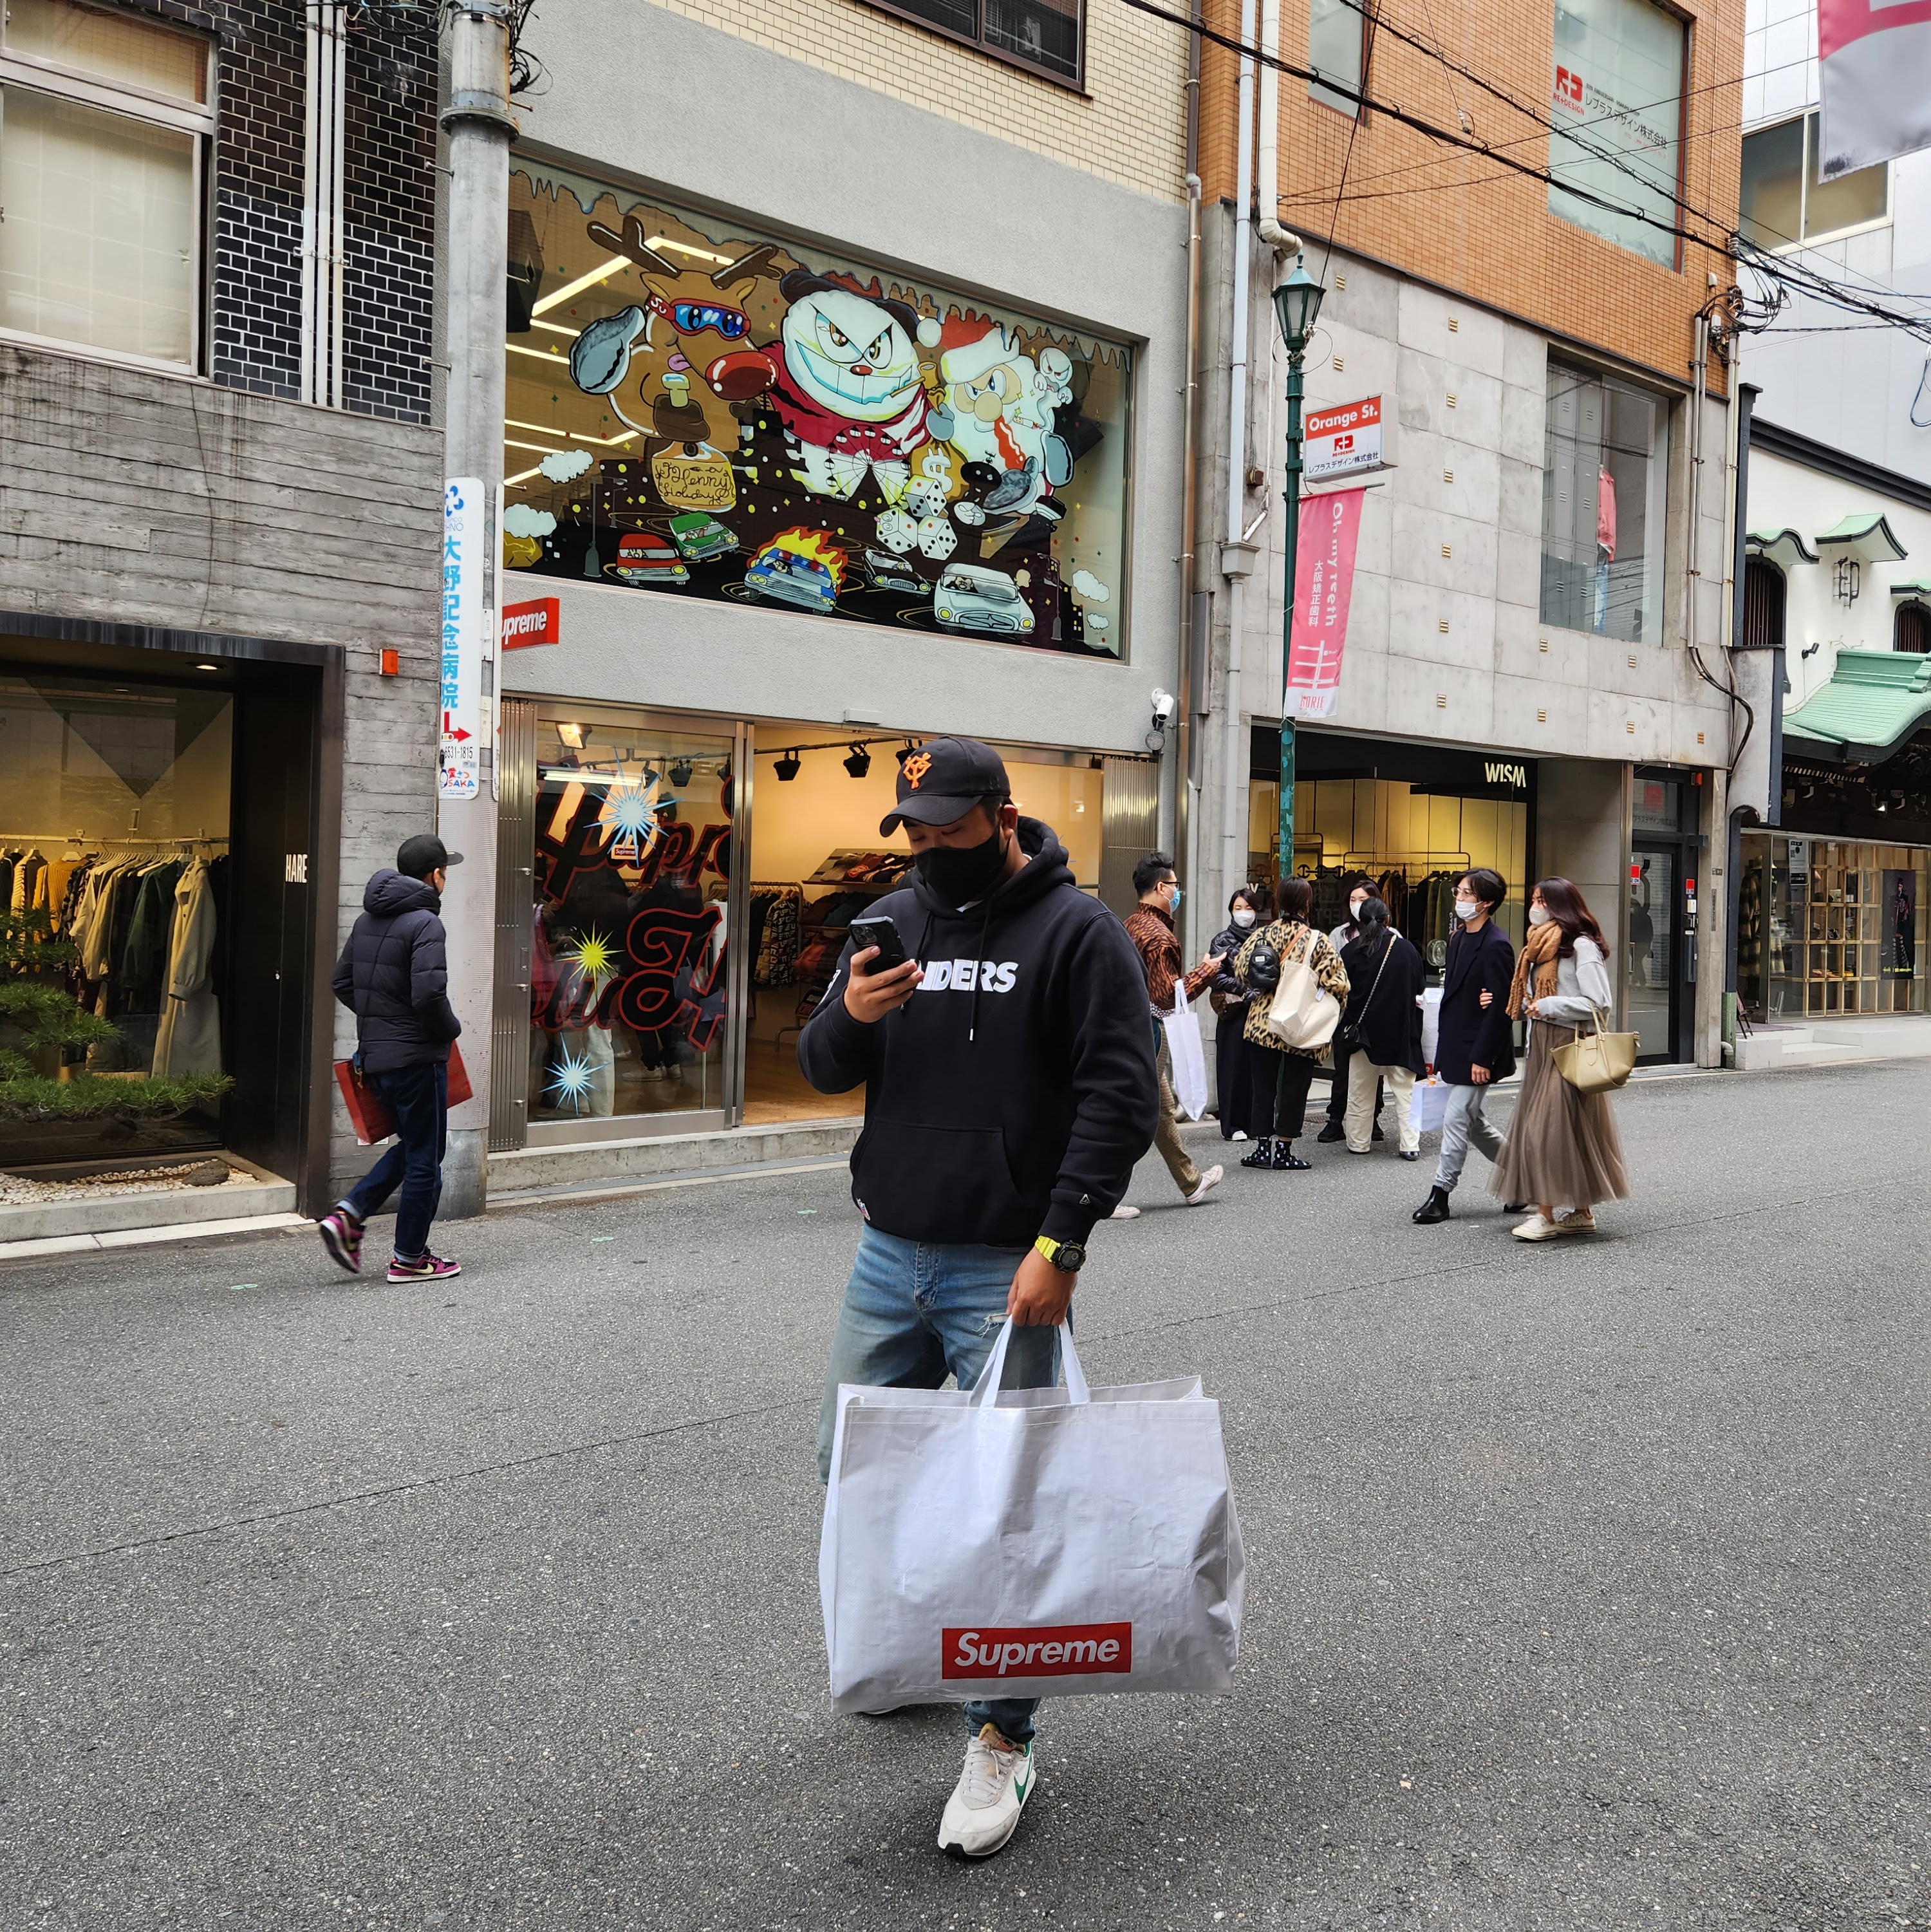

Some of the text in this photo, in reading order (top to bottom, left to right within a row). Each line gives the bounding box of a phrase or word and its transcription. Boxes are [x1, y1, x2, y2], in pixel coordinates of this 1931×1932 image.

[1553, 93, 1584, 116] RE+DESIGN
[1309, 404, 1378, 431] Orange St.
[1332, 502, 1343, 534] Oh
[1327, 539, 1339, 567] my
[1308, 560, 1323, 627] 大阪矯正歯科
[501, 611, 547, 645] upreme
[1484, 762, 1526, 787] WISM
[285, 854, 308, 883] HARE
[915, 959, 1019, 993] IDERS
[954, 1632, 1120, 1674] Supreme
